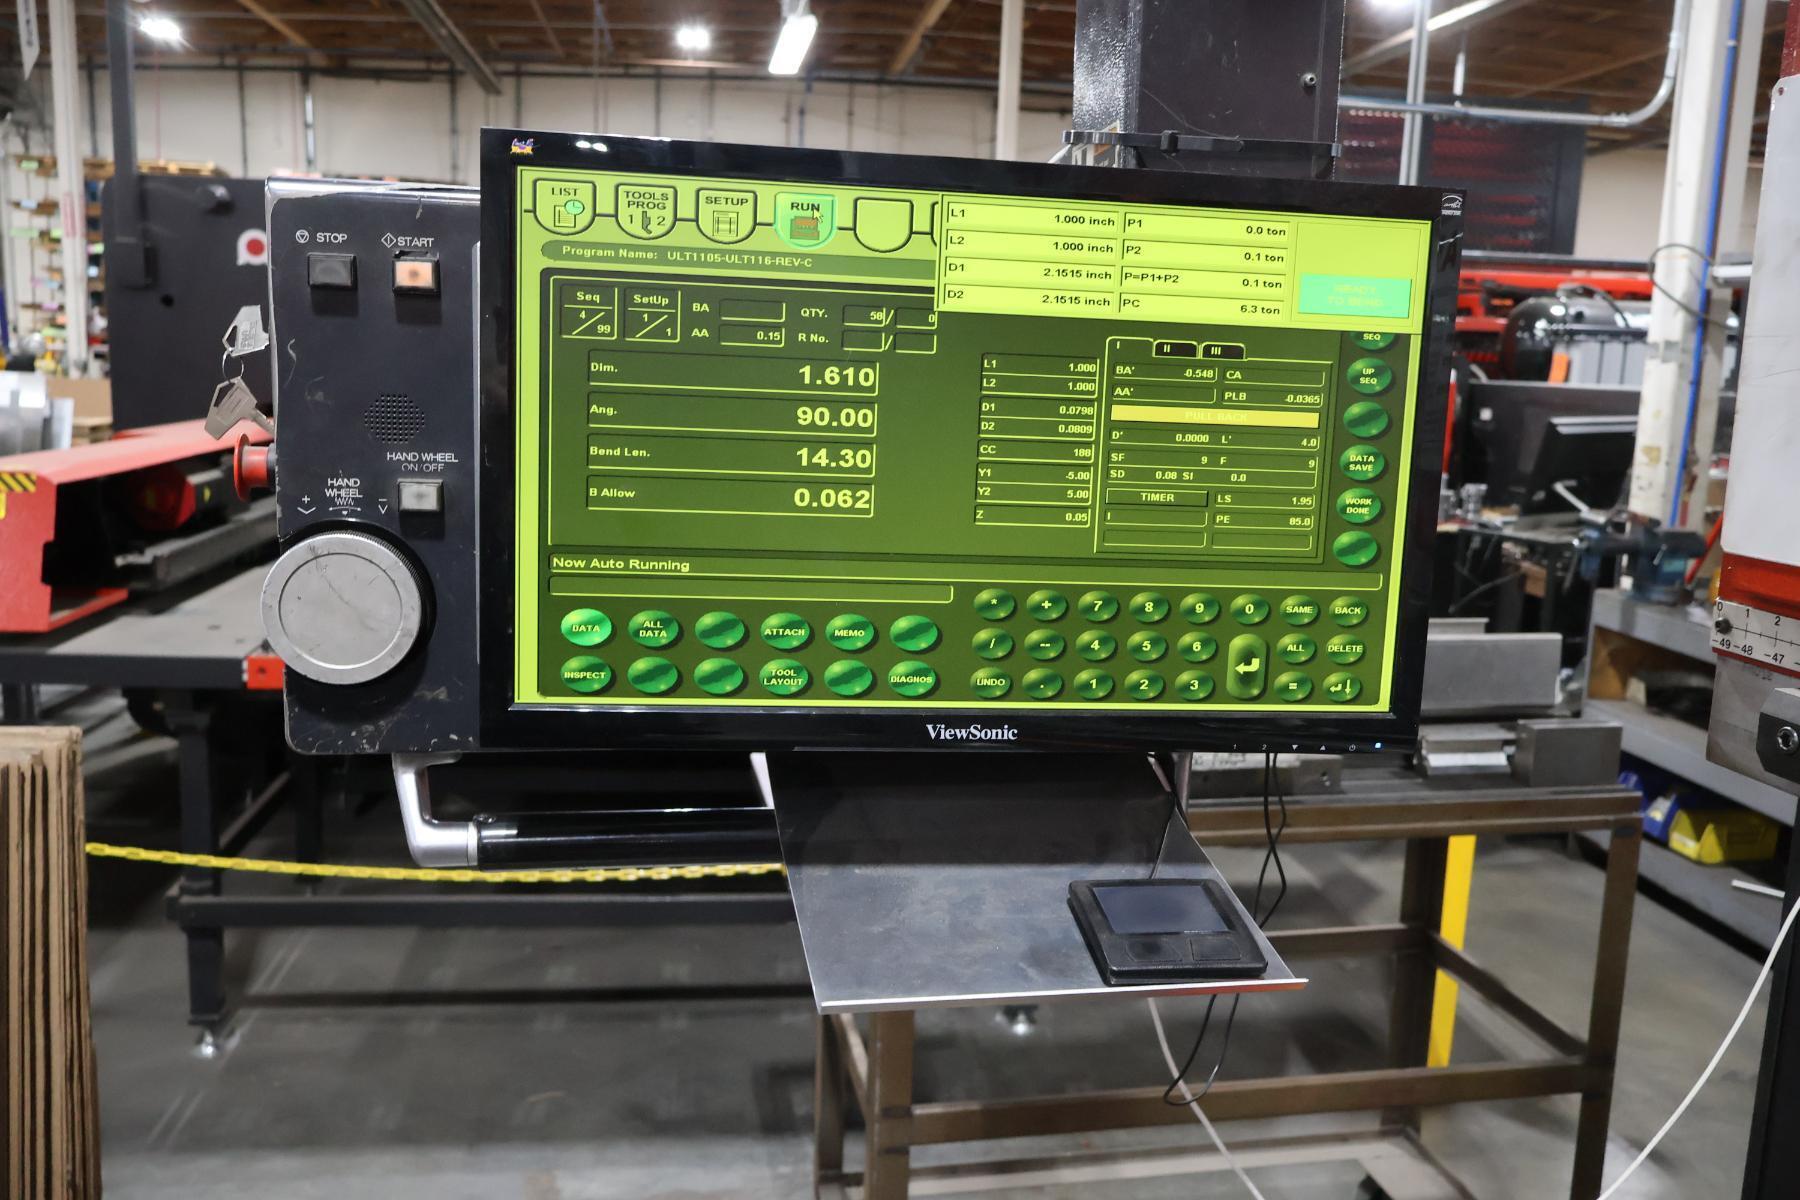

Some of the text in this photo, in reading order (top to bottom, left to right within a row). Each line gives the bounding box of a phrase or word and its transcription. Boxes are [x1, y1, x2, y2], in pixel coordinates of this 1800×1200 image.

[551, 187, 580, 197] LIST
[624, 190, 669, 202] TOOLS
[627, 201, 667, 212] PROG
[705, 196, 749, 207] SETUP
[791, 202, 821, 213] RUN
[951, 208, 965, 217] L1
[628, 214, 634, 224] 1
[657, 216, 666, 226] 2
[1054, 214, 1115, 226] 1.000 inch
[1127, 218, 1142, 228] P1
[1246, 225, 1286, 236] 0.0 ton
[316, 232, 347, 243] STOP
[397, 236, 434, 247] START
[950, 235, 964, 244] L2
[1053, 241, 1113, 253] 1.000 inch
[1126, 245, 1141, 254] P2
[562, 246, 813, 267] Program Name: ULT1105-ULT116-REV-C
[1244, 251, 1284, 262] 0.1 ton
[949, 262, 965, 272] D1
[1043, 268, 1112, 280] 2.1515 inch
[1124, 271, 1179, 283] P=P1+P2
[1242, 278, 1282, 289] 0.1 ton
[576, 291, 600, 304] Seq
[947, 289, 963, 299] D2
[633, 294, 669, 307] SetUp
[1042, 294, 1110, 307] 2.1515 inch
[1123, 298, 1140, 308] PC
[693, 303, 710, 312] BA
[1240, 304, 1280, 315] 6.3 ton
[579, 310, 586, 319] 4
[642, 313, 649, 322] 1
[801, 308, 828, 319] QTY.
[596, 324, 611, 334] 99
[665, 327, 672, 336] 1
[691, 328, 710, 337] AA
[756, 331, 782, 342] 0.15
[798, 333, 830, 343] R No.
[1363, 333, 1381, 341] SEQ
[984, 359, 997, 368] L1
[1068, 363, 1097, 373] 1.000
[799, 364, 876, 387] 1.610
[1226, 371, 1243, 381] CA
[1362, 368, 1375, 376] UP
[983, 378, 996, 387] L2
[1067, 382, 1096, 391] 1.000
[1359, 377, 1377, 386] SEQ
[1224, 392, 1247, 401] PLB
[590, 404, 618, 417] Ang.
[982, 402, 995, 412] D1
[1060, 406, 1094, 416] 0.0798
[796, 406, 874, 428] 90.00
[981, 421, 995, 430] D2
[1175, 433, 1209, 443] 0.0000
[1301, 438, 1317, 448] 4.0
[589, 447, 651, 459] Bend Len.
[980, 444, 997, 454] CC
[387, 451, 459, 462] HAND WHEEL
[796, 447, 872, 469] 14.30
[1111, 453, 1125, 462] SF
[1201, 456, 1209, 465] 9
[1220, 457, 1228, 465] F
[1349, 454, 1375, 463] DATA
[1308, 459, 1316, 468] 9
[1349, 463, 1374, 472] SAVE
[978, 467, 992, 477] Y1
[1110, 469, 1125, 478] SD
[1155, 471, 1178, 480] 0.08
[1230, 473, 1247, 482] 0.0
[327, 478, 361, 488] HAND
[324, 488, 363, 498] WHEEL
[589, 488, 636, 500] B Allow
[977, 487, 991, 496] Y2
[794, 488, 871, 511] 0.062
[1140, 492, 1175, 503] TIMER
[1217, 495, 1232, 504] LS
[1291, 496, 1312, 506] 1.95
[1345, 498, 1372, 506] WORK
[976, 510, 984, 519] Z
[1346, 507, 1370, 515] DONE
[1066, 513, 1088, 523] 0.05
[1216, 515, 1231, 524] PE
[1289, 517, 1311, 527] 85.0
[553, 557, 690, 574] Now Auto Running
[1093, 601, 1103, 611] 7
[1144, 602, 1154, 612] 8
[1195, 603, 1204, 613] 9
[1245, 604, 1254, 614] 0
[1286, 606, 1313, 615] SAME
[1716, 602, 1724, 611] 0
[1335, 607, 1361, 616] BACK
[1745, 608, 1751, 618] 1
[643, 621, 664, 629] ALL
[1774, 616, 1781, 626] 2
[572, 623, 601, 633] DATA
[764, 628, 805, 637] ATTACH
[639, 630, 668, 639] DATA
[834, 630, 865, 639] MEMO
[1091, 640, 1100, 651] 4
[1142, 641, 1151, 652] 5
[1192, 642, 1201, 652] 6
[1287, 644, 1305, 653] ALL
[1328, 645, 1363, 654] DELETE
[1712, 638, 1785, 664] -49 -48 -47
[564, 671, 606, 680] INSPECT
[770, 669, 797, 678] TOOL
[763, 678, 803, 687] LAYOUT
[890, 676, 933, 685] DIAGNOS
[976, 678, 1006, 687] UNDO
[1089, 680, 1097, 689] 1
[1139, 680, 1149, 691] 2
[1189, 680, 1199, 691] 3
[925, 723, 1018, 740] ViewSonic
